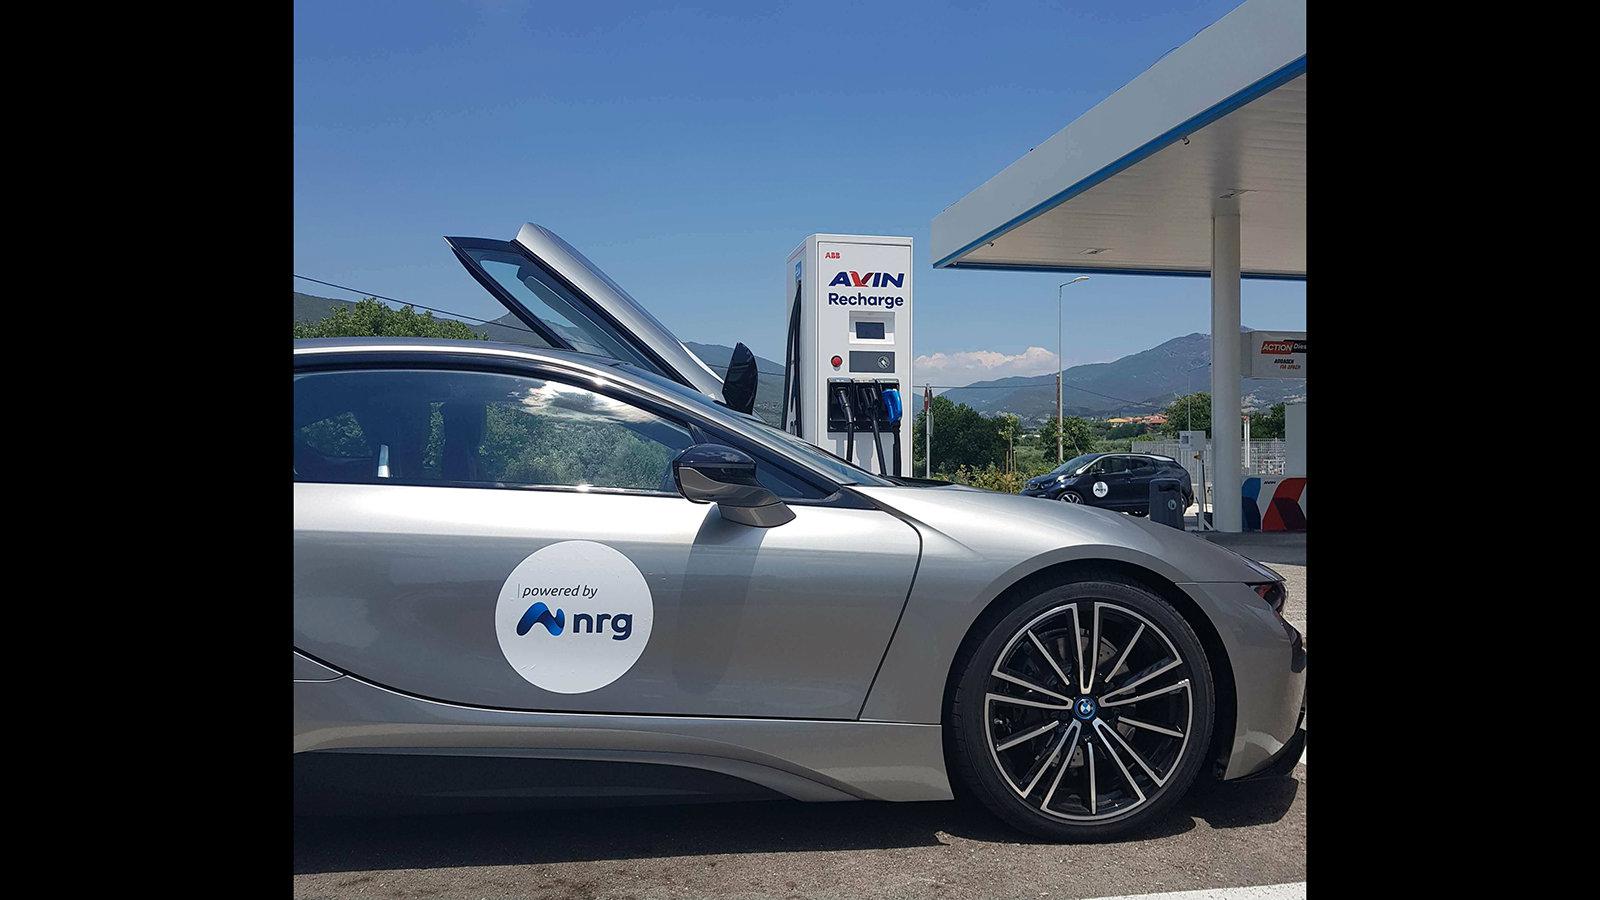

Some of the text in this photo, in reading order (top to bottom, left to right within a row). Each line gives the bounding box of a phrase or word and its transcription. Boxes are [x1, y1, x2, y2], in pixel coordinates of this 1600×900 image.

[828, 271, 905, 288] AVIN
[828, 292, 904, 309] Recharge
[1262, 343, 1293, 351] ACTION
[522, 585, 598, 599] powered by
[573, 613, 633, 641] nrg
